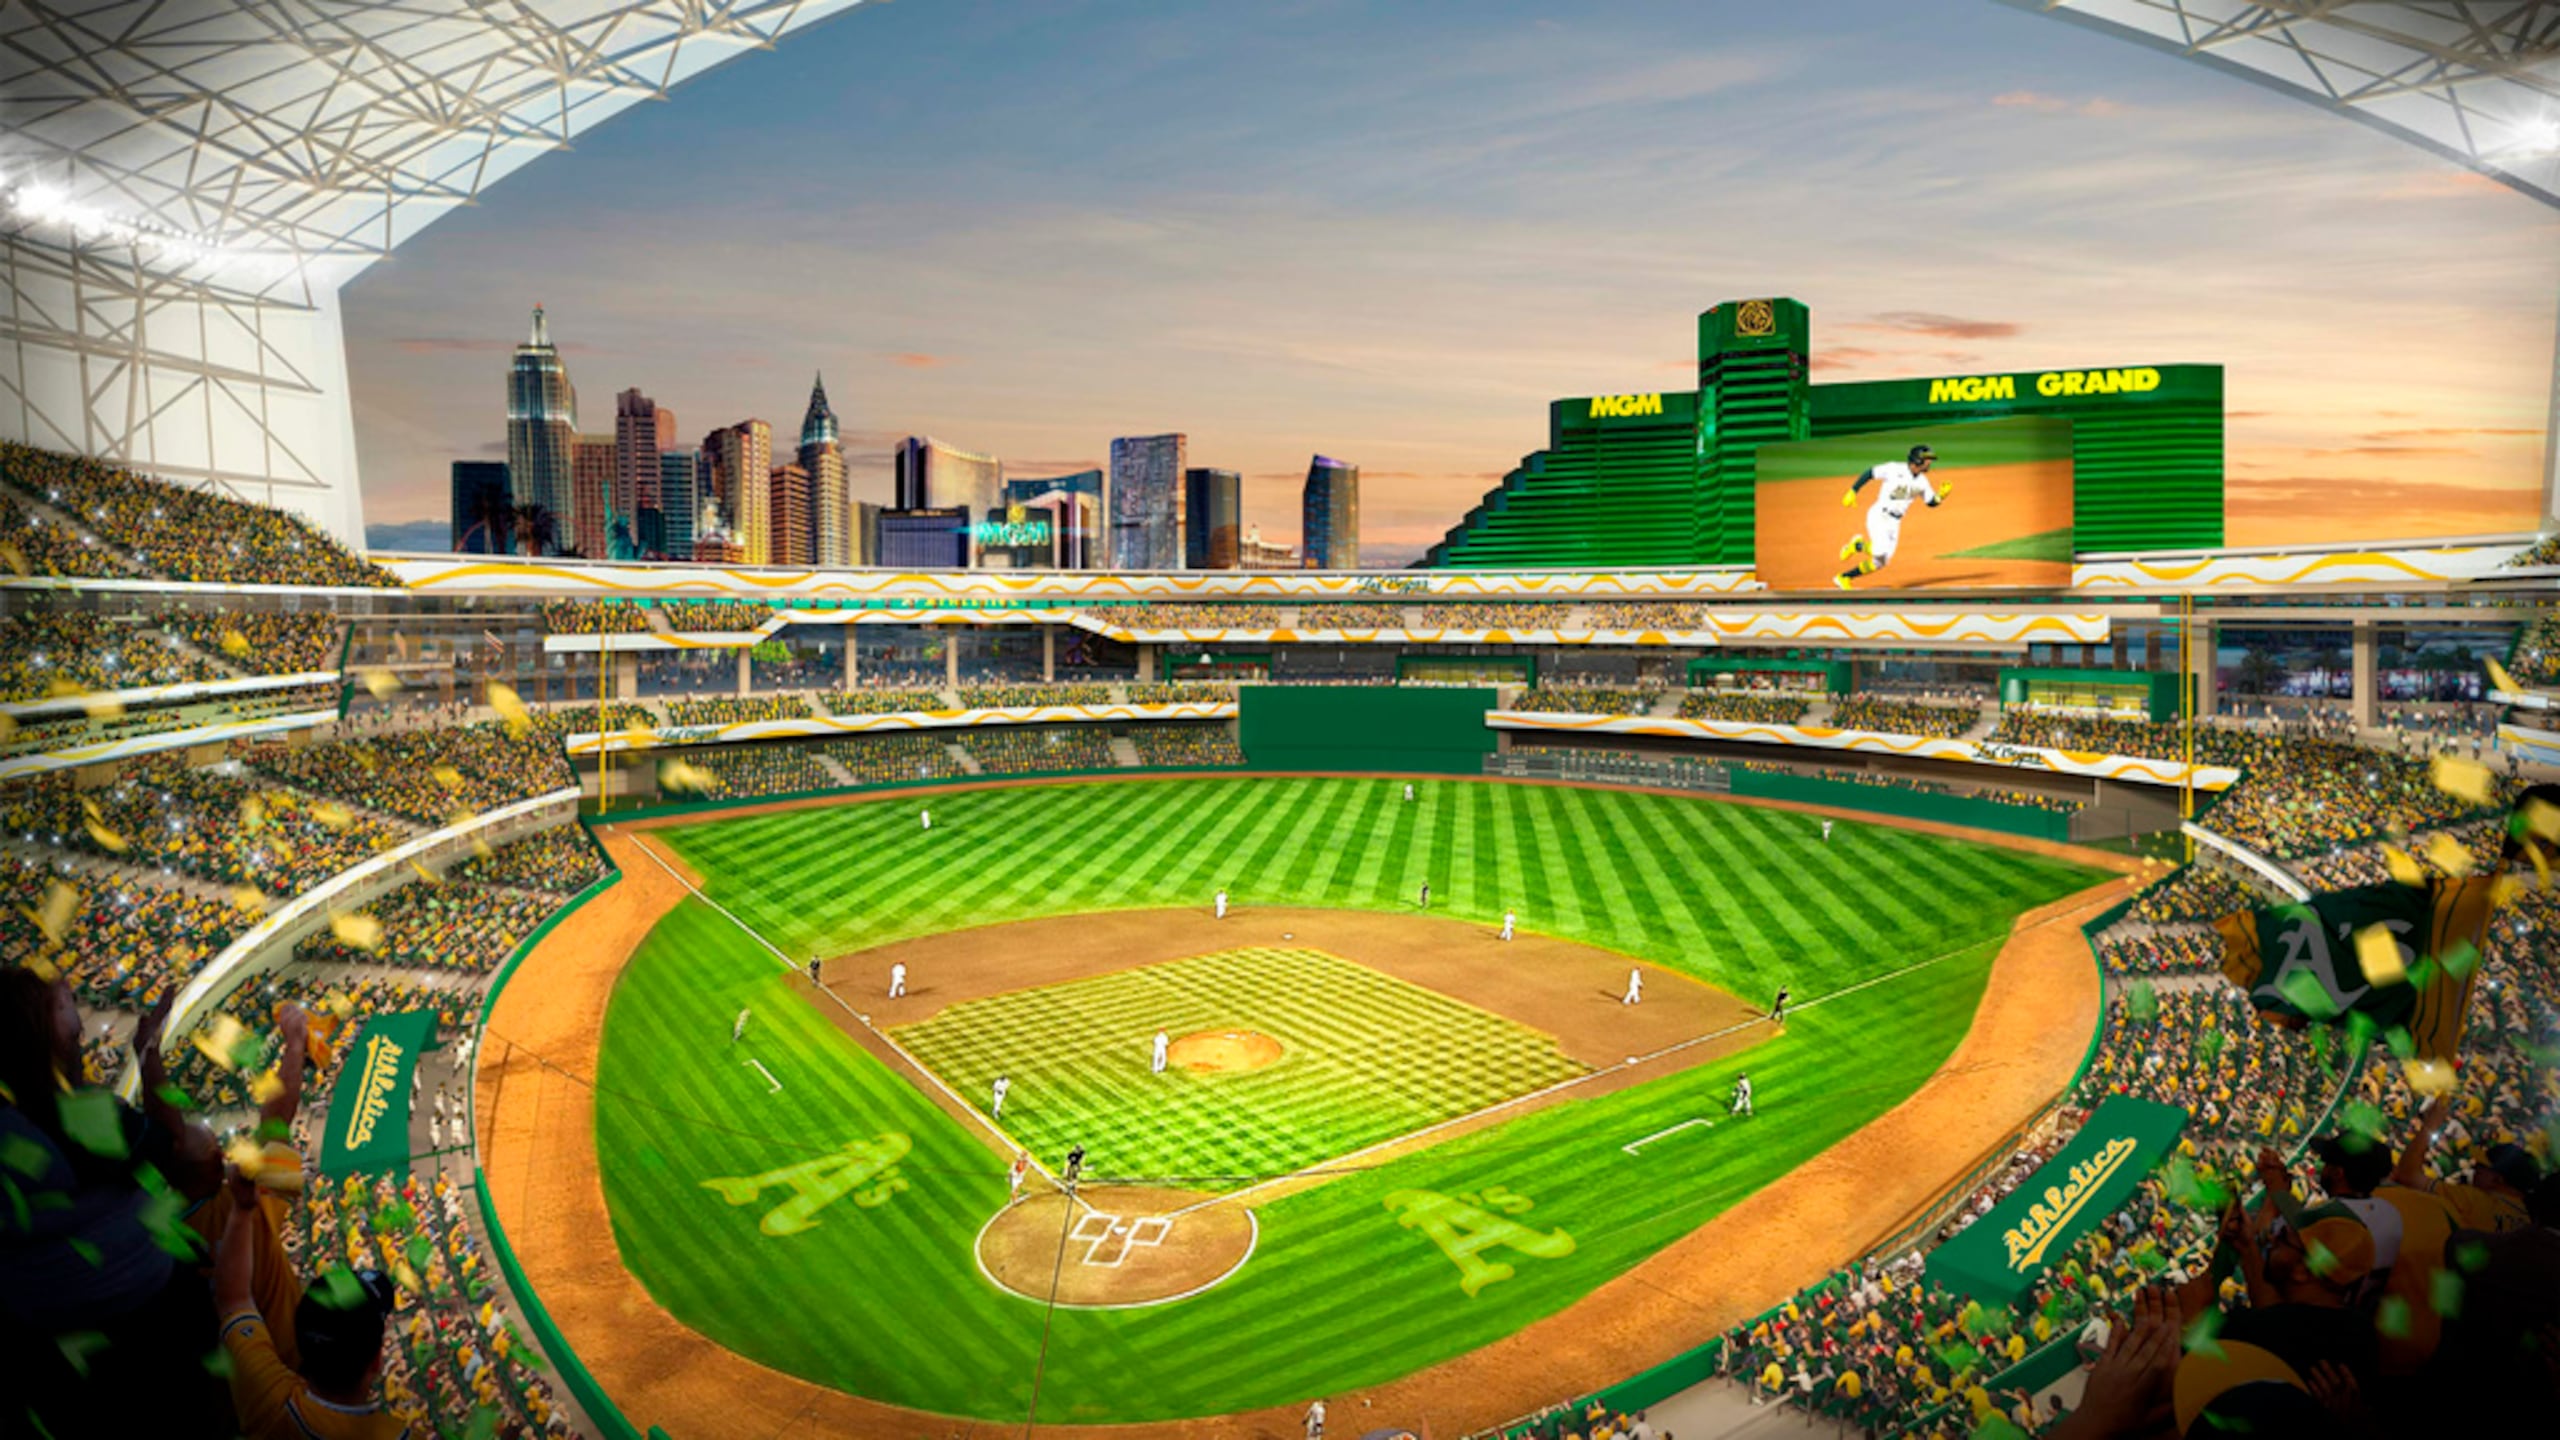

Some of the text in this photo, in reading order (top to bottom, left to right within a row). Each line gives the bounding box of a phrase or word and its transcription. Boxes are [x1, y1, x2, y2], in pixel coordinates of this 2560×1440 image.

[1928, 366, 2161, 403] MGM GRAND
[1589, 393, 1663, 418] MGM
[976, 521, 1049, 547] MGM
[345, 1034, 403, 1151] Athletics
[2002, 1137, 2137, 1273] Athletics
